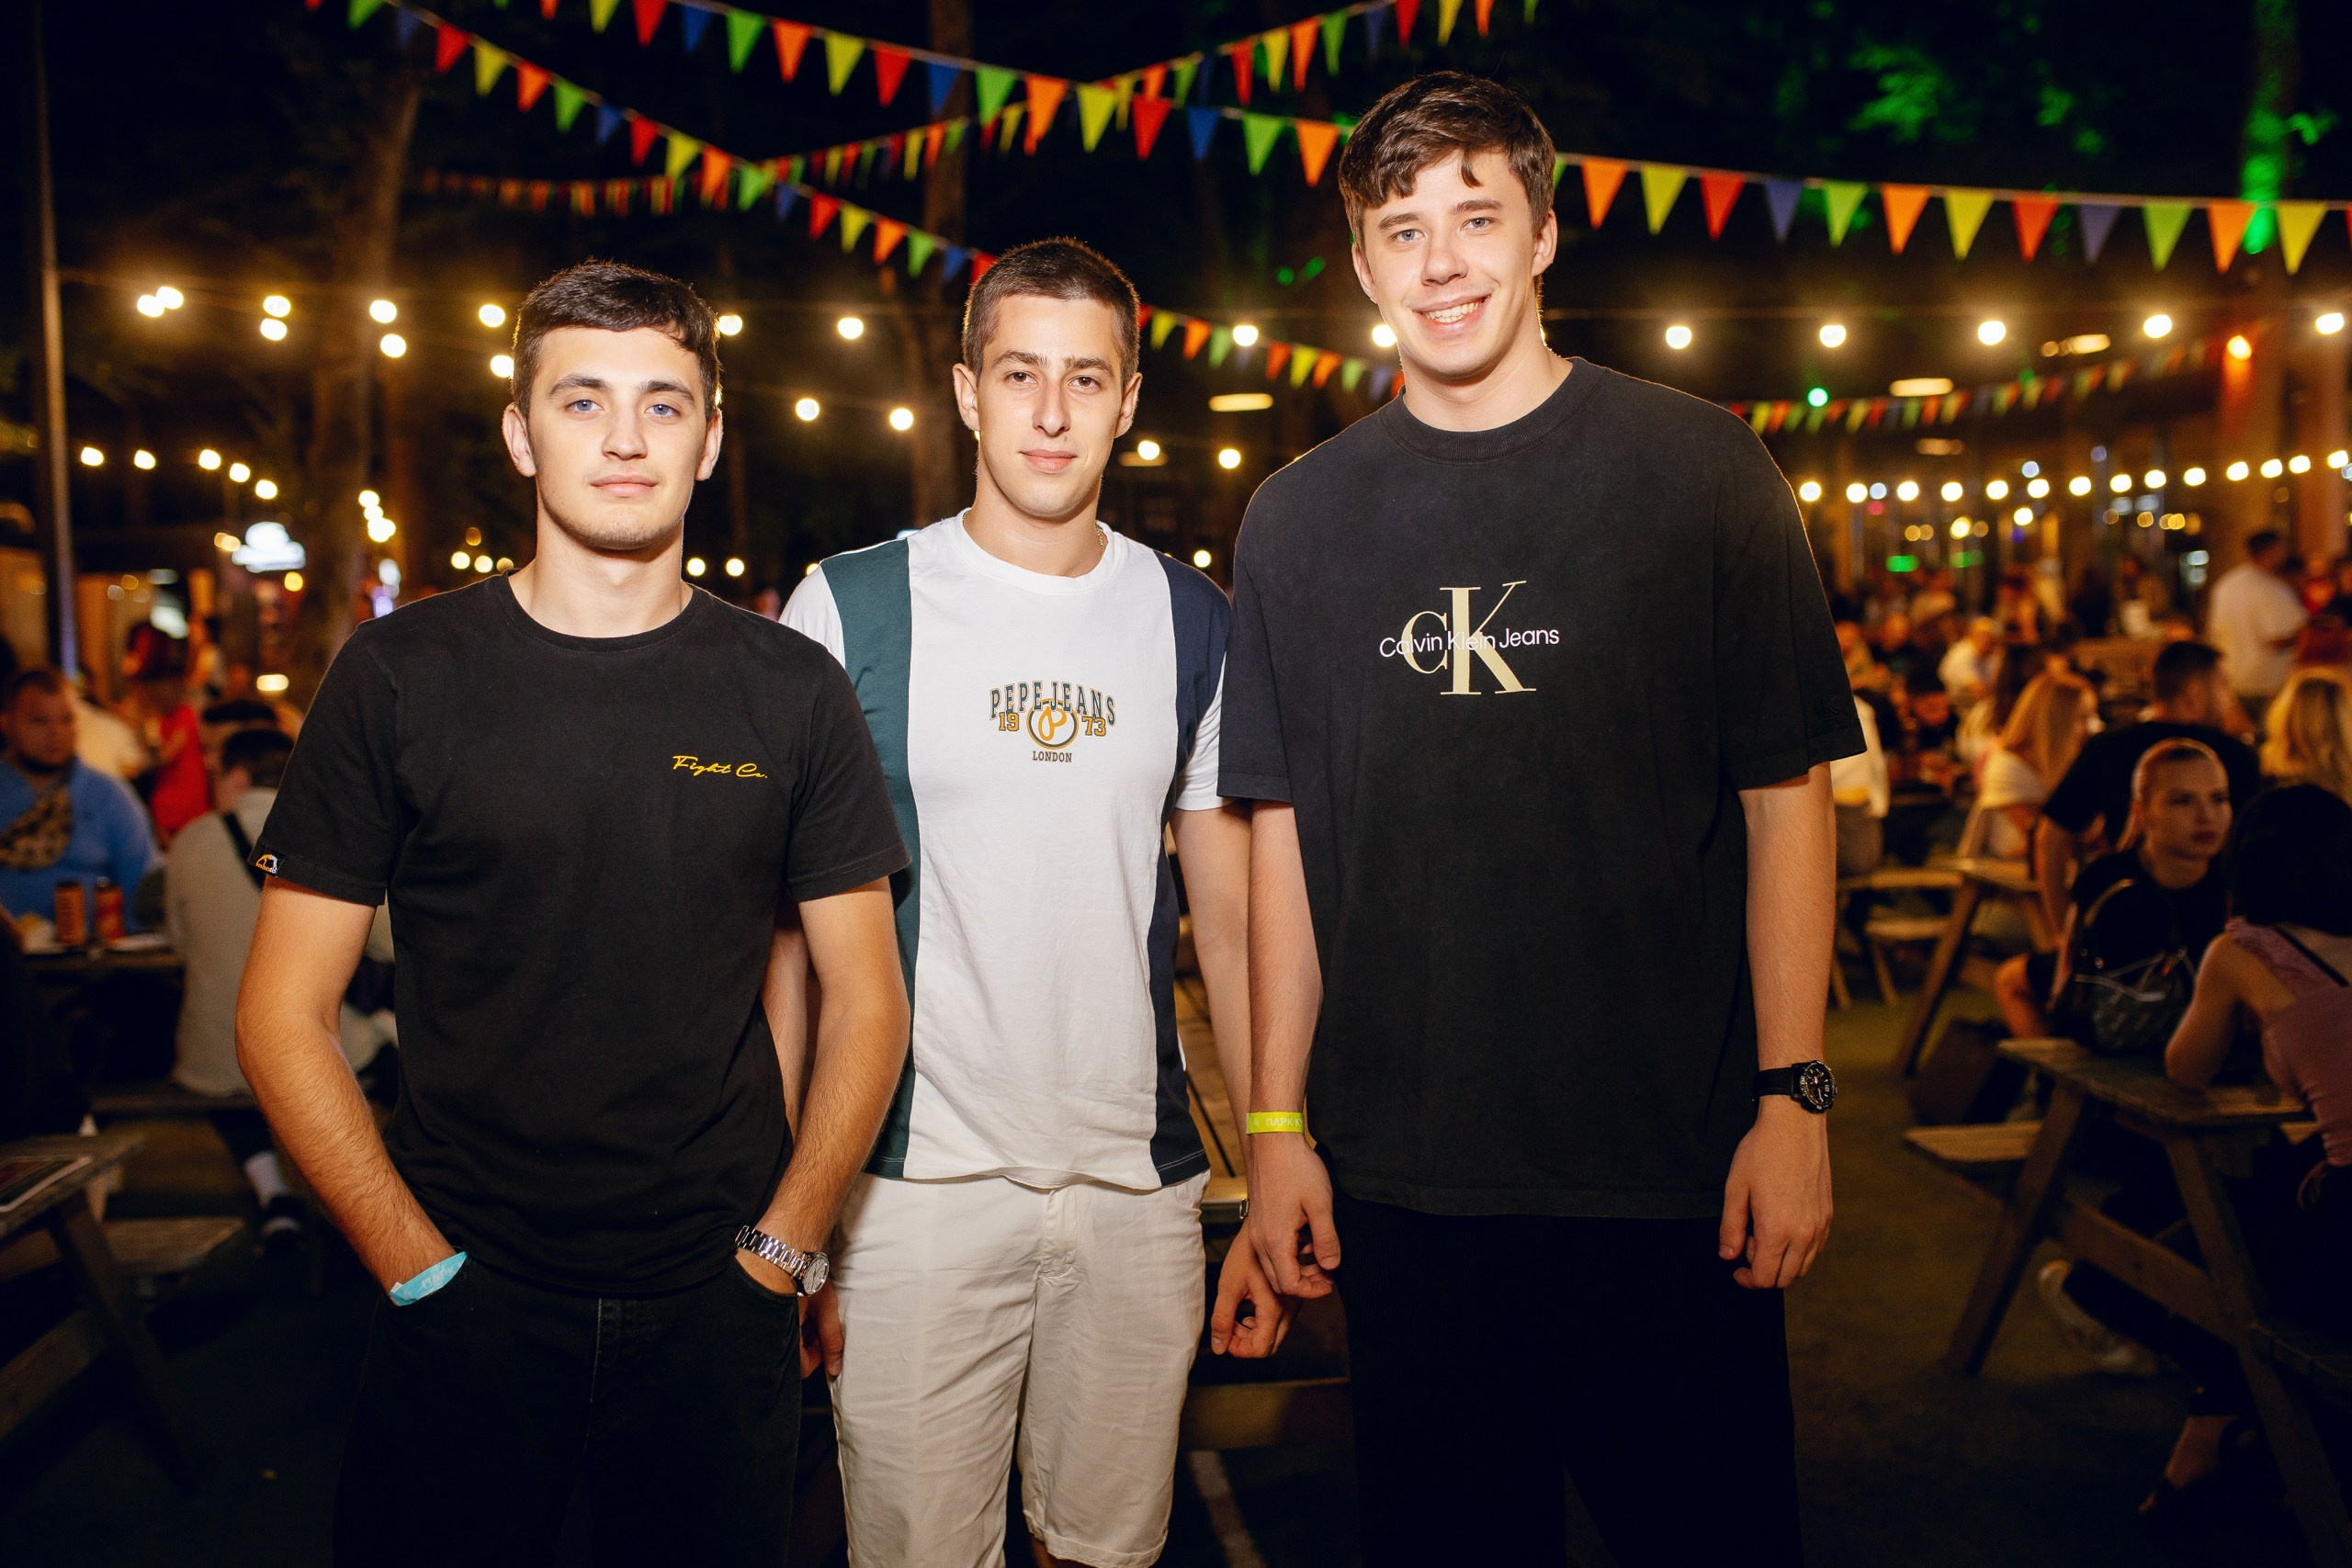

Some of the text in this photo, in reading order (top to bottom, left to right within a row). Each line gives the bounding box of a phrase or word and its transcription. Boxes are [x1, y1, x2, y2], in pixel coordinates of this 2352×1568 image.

[1379, 627, 1560, 658] Calvin Klein Jeans
[989, 681, 1116, 727] PEPE JEANS
[999, 711, 1107, 737] 19 73
[673, 755, 731, 776] Fight
[1033, 750, 1072, 762] LONDON
